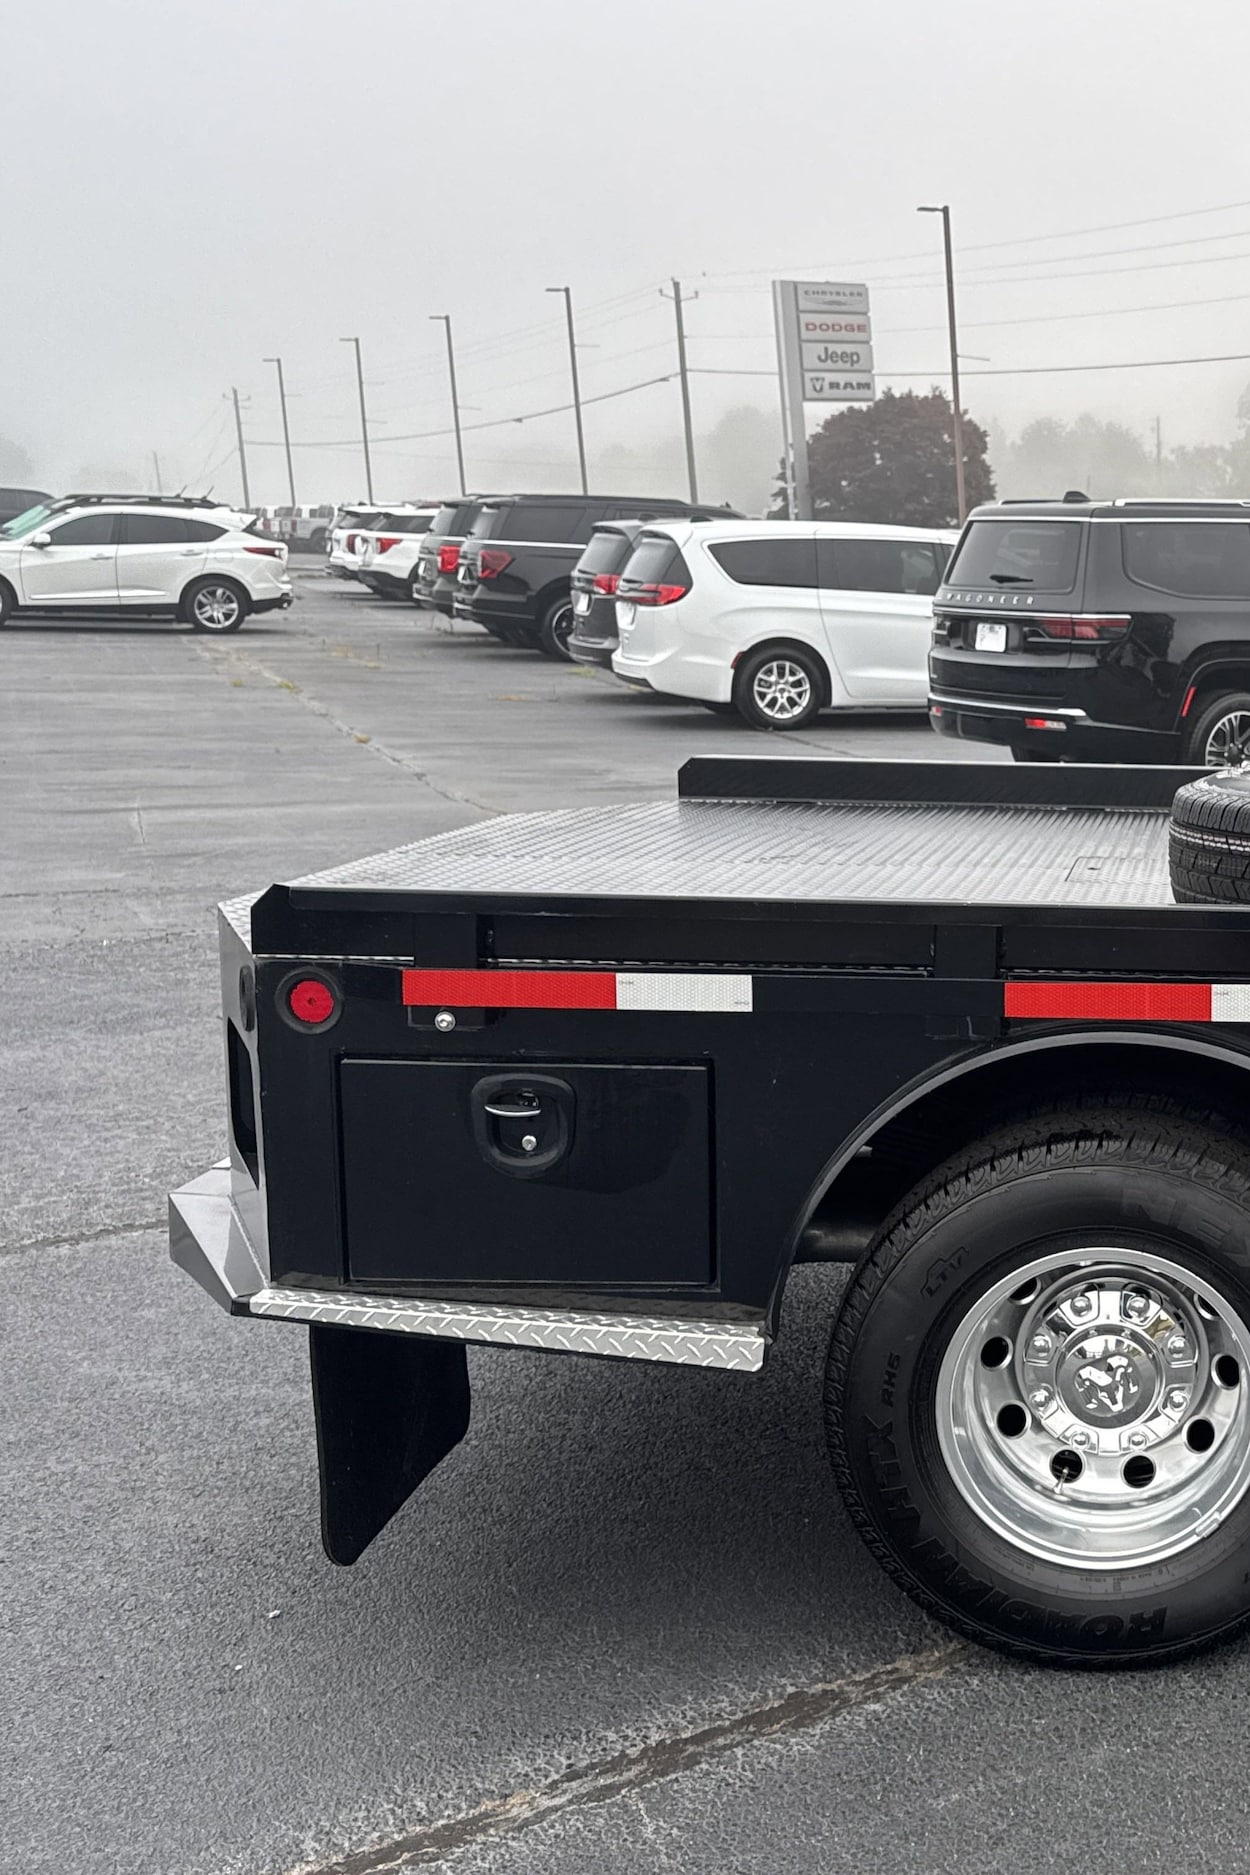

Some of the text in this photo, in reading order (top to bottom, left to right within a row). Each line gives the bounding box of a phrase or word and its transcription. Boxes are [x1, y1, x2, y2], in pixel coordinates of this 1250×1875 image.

[803, 290, 864, 298] CHRYSLER
[804, 322, 867, 333] DODGE
[817, 346, 860, 367] Jeep
[828, 381, 872, 391] RAM
[910, 1535, 1169, 1640] ROADIAN
